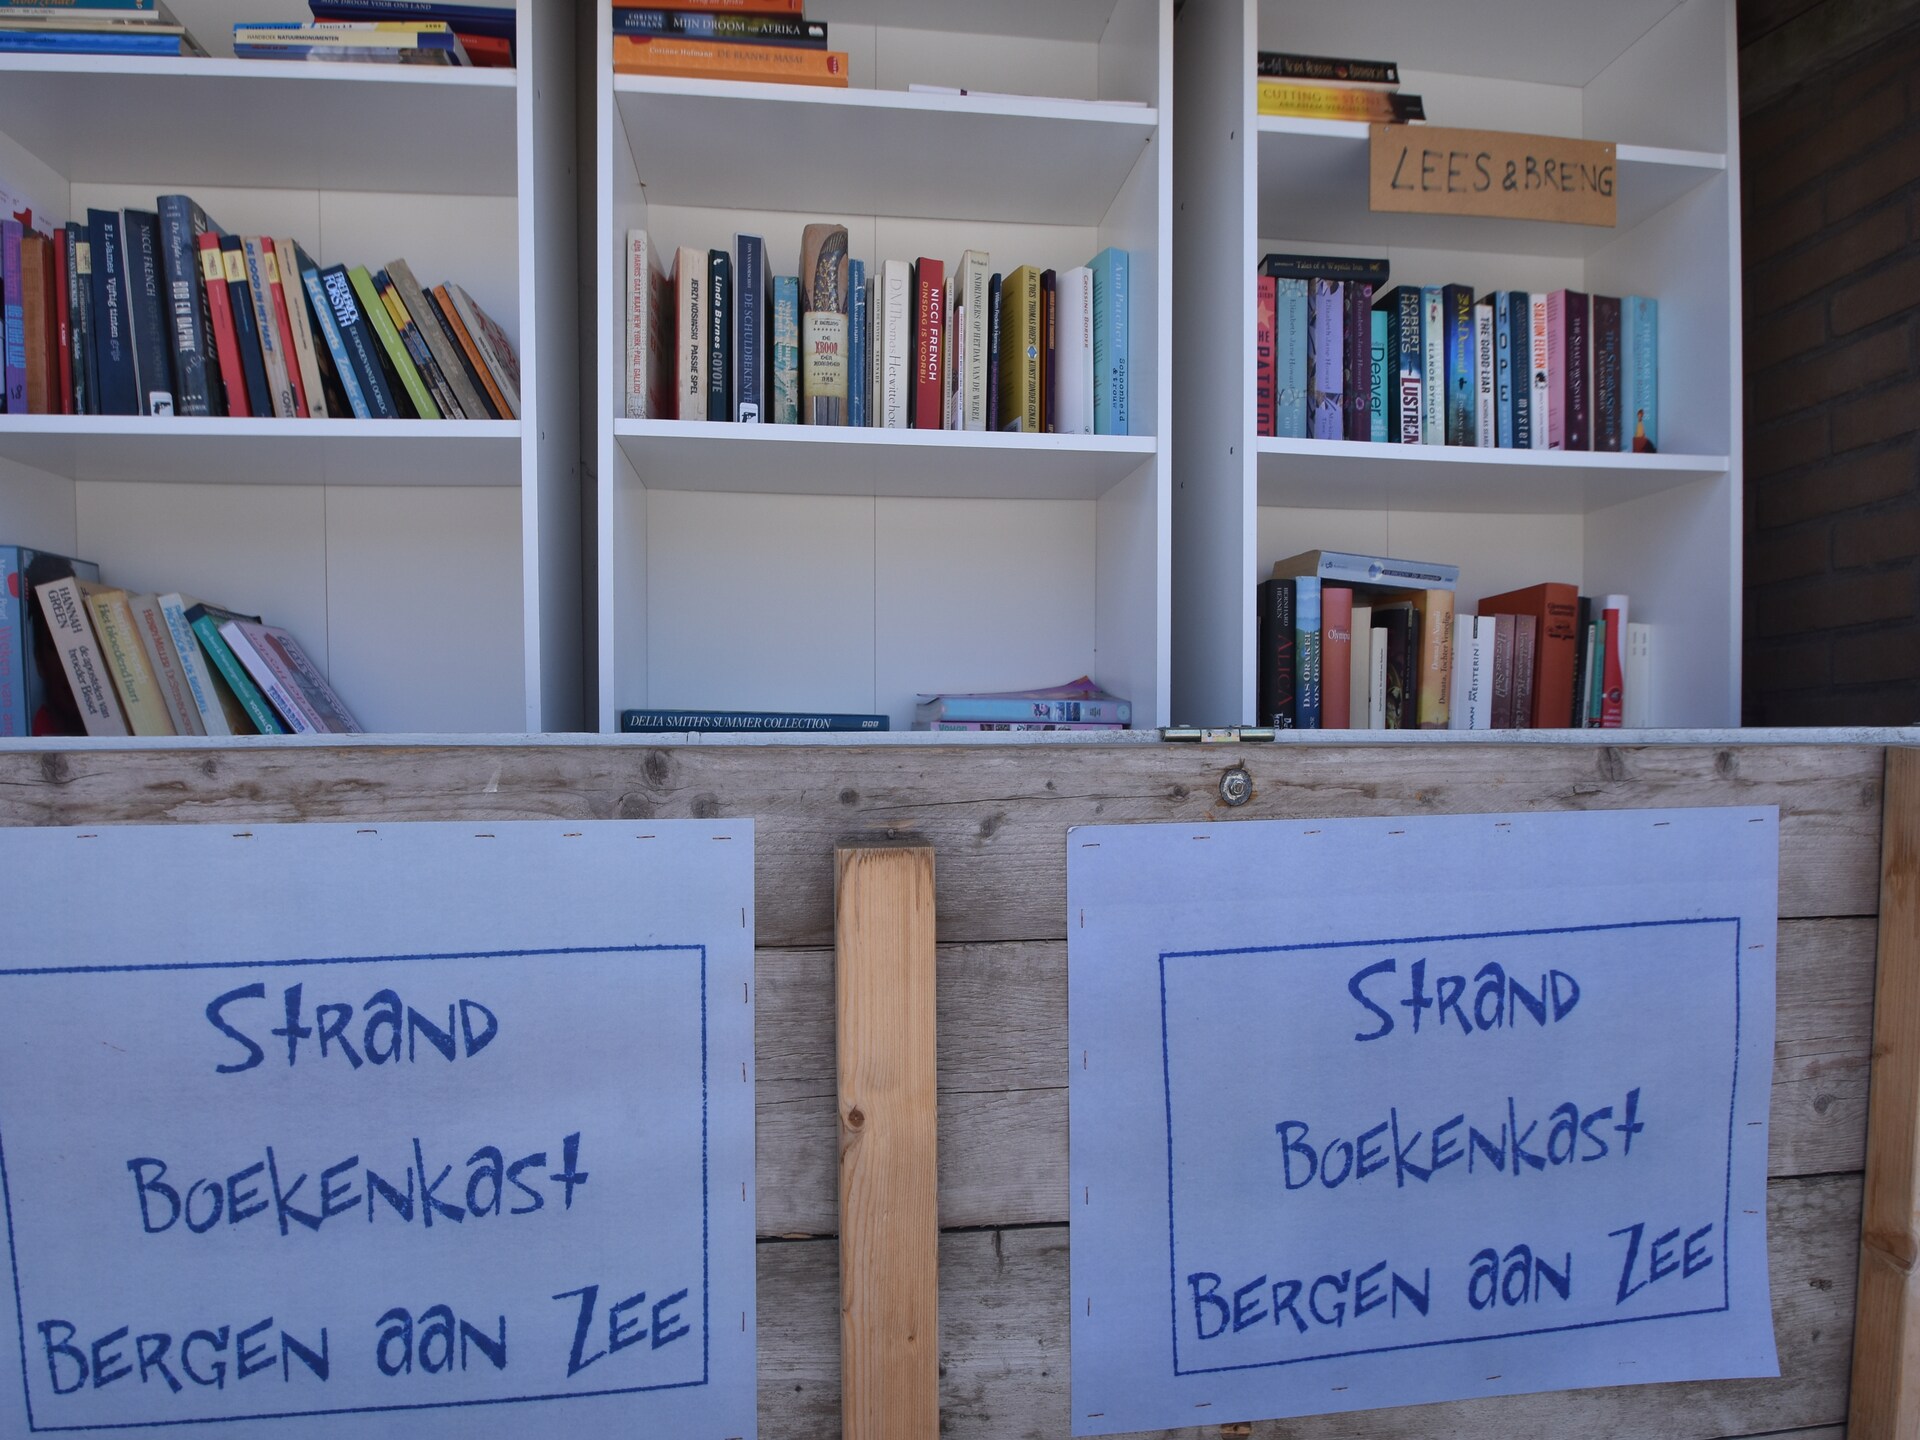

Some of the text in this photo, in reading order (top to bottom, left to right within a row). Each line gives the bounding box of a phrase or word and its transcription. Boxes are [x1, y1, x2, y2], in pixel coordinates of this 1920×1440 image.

[702, 20, 746, 32] DROOM
[761, 24, 800, 35] AFRIKA
[1391, 145, 1614, 197] LEES & BRENG
[171, 221, 180, 233] De
[105, 242, 116, 273] James
[141, 225, 156, 297] NICCI FRENCH
[170, 234, 182, 259] liefde
[106, 277, 118, 307] Vijftig
[172, 280, 189, 300] BOB
[174, 301, 191, 315] EN
[245, 243, 272, 352] DE DOOD IN HET HART
[324, 275, 353, 328] FORSYTH
[334, 272, 360, 323] FREDERICK
[745, 293, 754, 306] DE
[973, 272, 982, 319] INDRINGERS
[1115, 263, 1124, 348] Ann Patchett
[109, 308, 120, 338] tinten
[177, 316, 195, 353] DAPHNE
[711, 275, 723, 393] Linda Barnes COYOTE
[921, 328, 928, 337] IS
[928, 288, 939, 380] NICCI FRENCH
[973, 321, 980, 332] OP
[1324, 299, 1332, 337] Elizabeth
[1401, 293, 1411, 353] HARRIS
[1410, 295, 1419, 355] ROBERT
[1481, 317, 1490, 335] THE
[1534, 303, 1547, 369] STATION ELEVEN
[972, 348, 980, 363] DAK
[1028, 284, 1037, 428] TOES THOMAS HOEPS KUNST ZONDER GENADE
[1288, 337, 1296, 357] Jane
[1457, 306, 1470, 373] McDermid
[1481, 339, 1490, 368] GOOD
[690, 344, 698, 373] PASSIE
[889, 355, 900, 377] Het
[972, 366, 980, 380] VAN
[1288, 358, 1296, 390] Howard
[1324, 358, 1332, 390] Howard
[633, 368, 641, 394] GALLICO
[690, 375, 698, 395] SPEL
[972, 382, 980, 392] DE
[1371, 347, 1385, 416] Deaver
[1481, 371, 1490, 394] LIAR
[1573, 380, 1581, 411] SISTER
[370, 385, 387, 415] OORLOG
[1606, 393, 1615, 435] SISTER
[48, 590, 69, 629] GREEN
[58, 587, 83, 634] HANNAH
[98, 603, 139, 704] Het bloedend hart
[1278, 634, 1293, 706] ALICA
[1303, 634, 1312, 681] ORAKEL
[1495, 632, 1506, 698] Herz aus Stahl
[68, 649, 97, 715] broeder Bisset
[79, 646, 110, 719] de apostelen van
[1471, 648, 1479, 701] MEISTERIN
[630, 715, 832, 729] DELIA SMITH'S SUMMER COLLECTION
[1188, 1260, 1430, 1340] BERGEN
[1608, 1222, 1713, 1305] ZEE
[38, 1317, 330, 1394] BERGEN
[552, 1285, 692, 1378] ZEE
